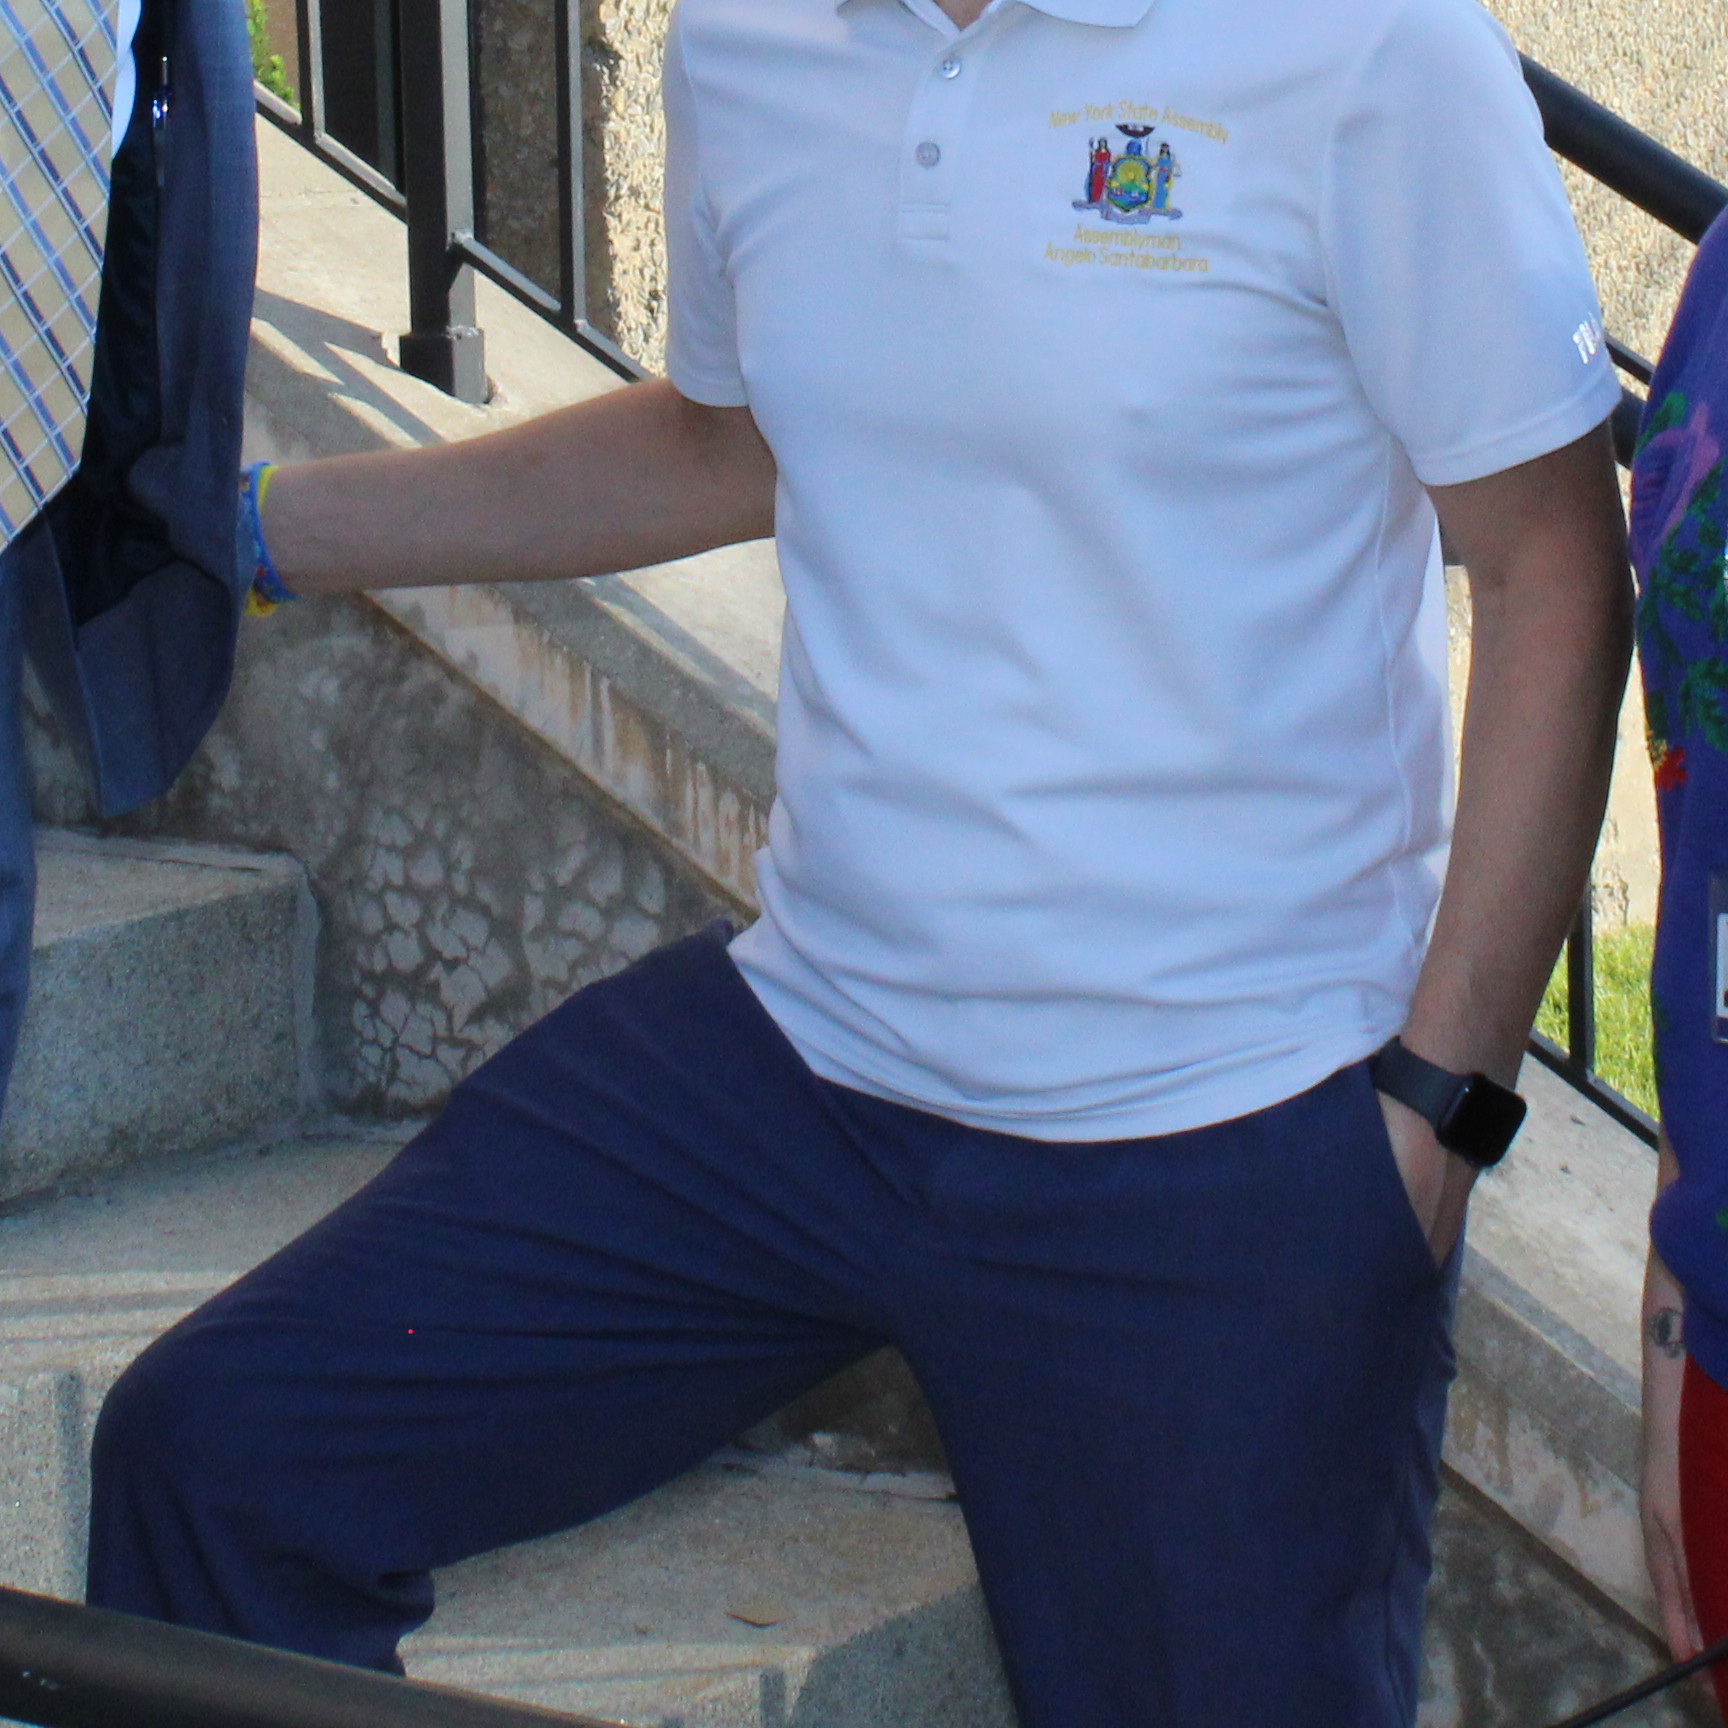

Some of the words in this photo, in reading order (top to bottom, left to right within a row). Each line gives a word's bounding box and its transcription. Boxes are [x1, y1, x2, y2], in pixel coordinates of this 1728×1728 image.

[1050, 111, 1080, 127] New
[1085, 104, 1114, 120] York
[1119, 101, 1159, 120] State
[1162, 106, 1229, 145] Assembly
[1074, 224, 1181, 249] Assemblyman
[1045, 243, 1097, 267] Angelo
[1100, 247, 1209, 272] Santabarbara
